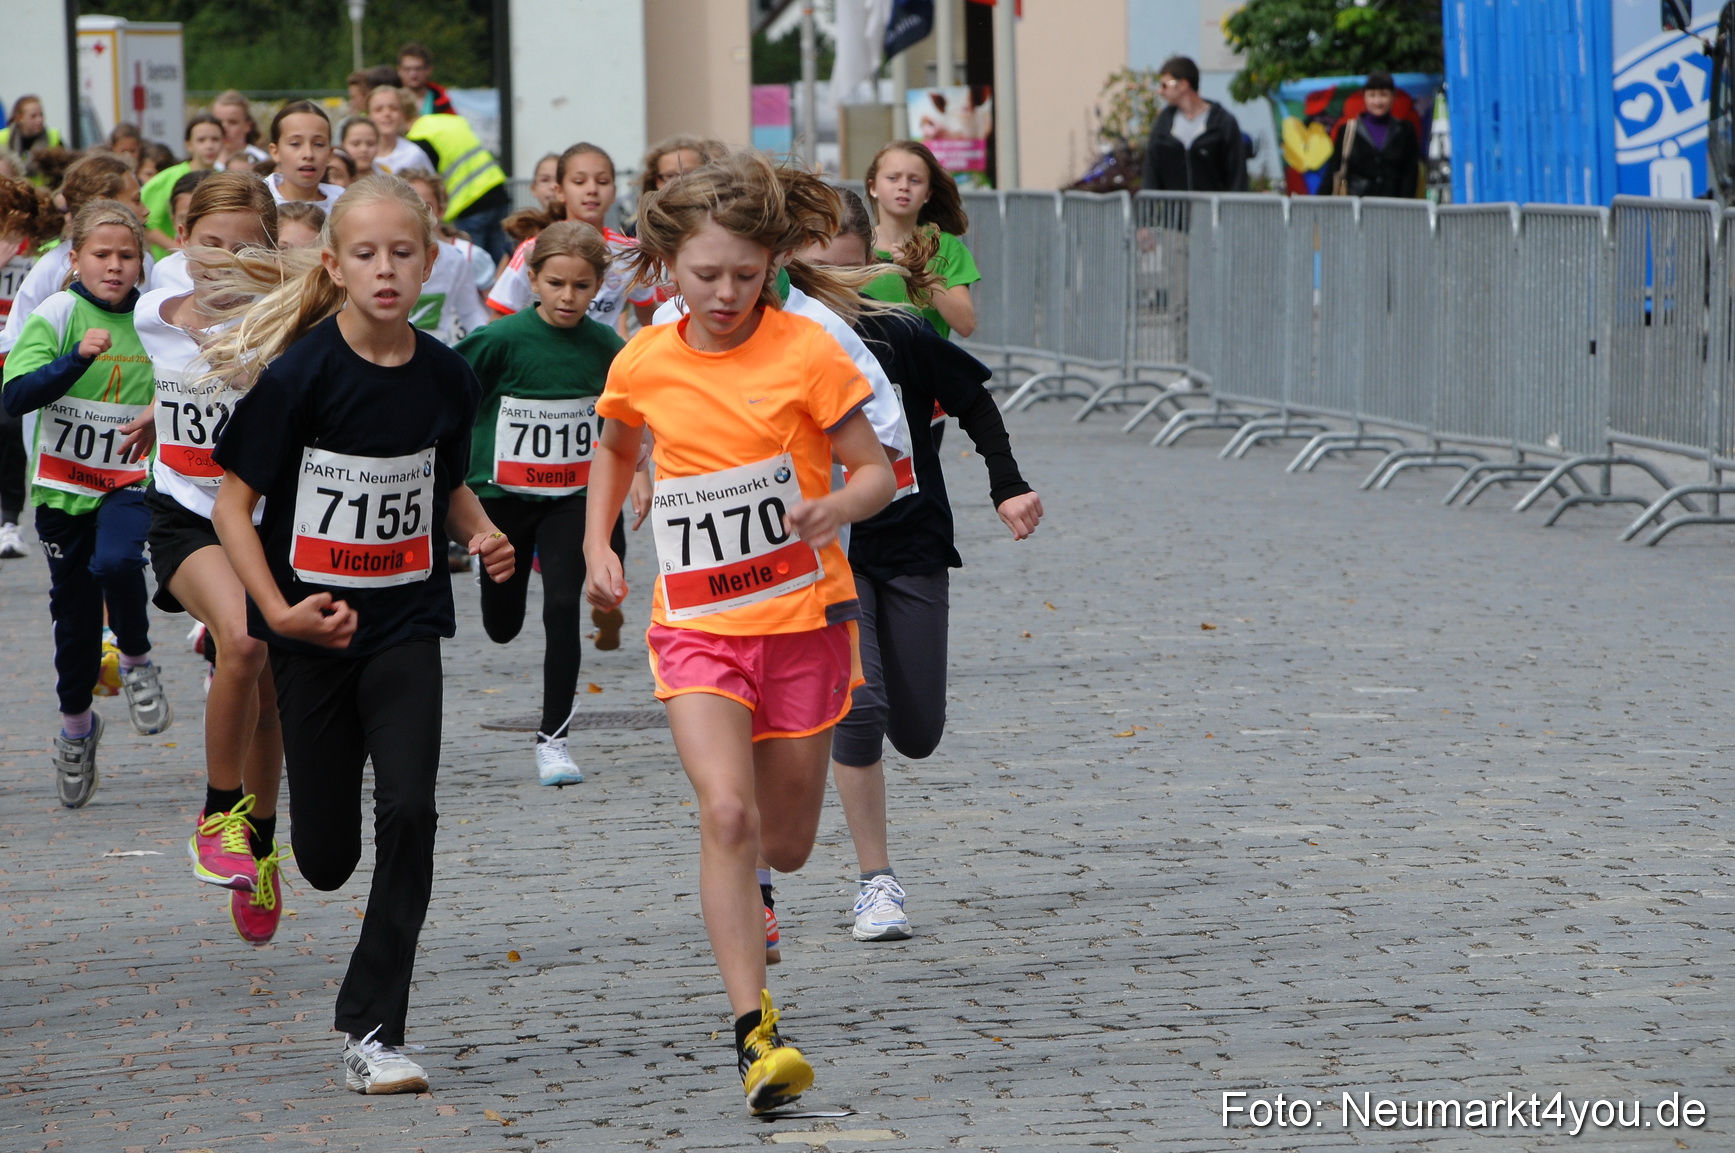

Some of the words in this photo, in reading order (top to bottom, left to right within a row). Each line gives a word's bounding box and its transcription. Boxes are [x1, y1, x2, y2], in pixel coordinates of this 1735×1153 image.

[44, 403, 82, 420] PARTL
[84, 410, 135, 424] Neumarkt
[501, 406, 536, 419] PARTL
[539, 406, 586, 420] Neumarkt
[509, 421, 592, 459] 7019
[68, 466, 117, 489] Janika
[304, 461, 355, 482] PARTL
[359, 468, 421, 484] Neumarkt
[526, 467, 577, 487] Svenja
[653, 492, 694, 509] PARTL
[696, 477, 770, 504] Neumarkt
[316, 487, 423, 541] 7155
[300, 524, 306, 534] 5
[421, 524, 428, 533] W
[667, 496, 791, 567] 7170
[330, 547, 404, 571] Victoria
[665, 562, 672, 571] 5
[708, 564, 774, 597] Merle
